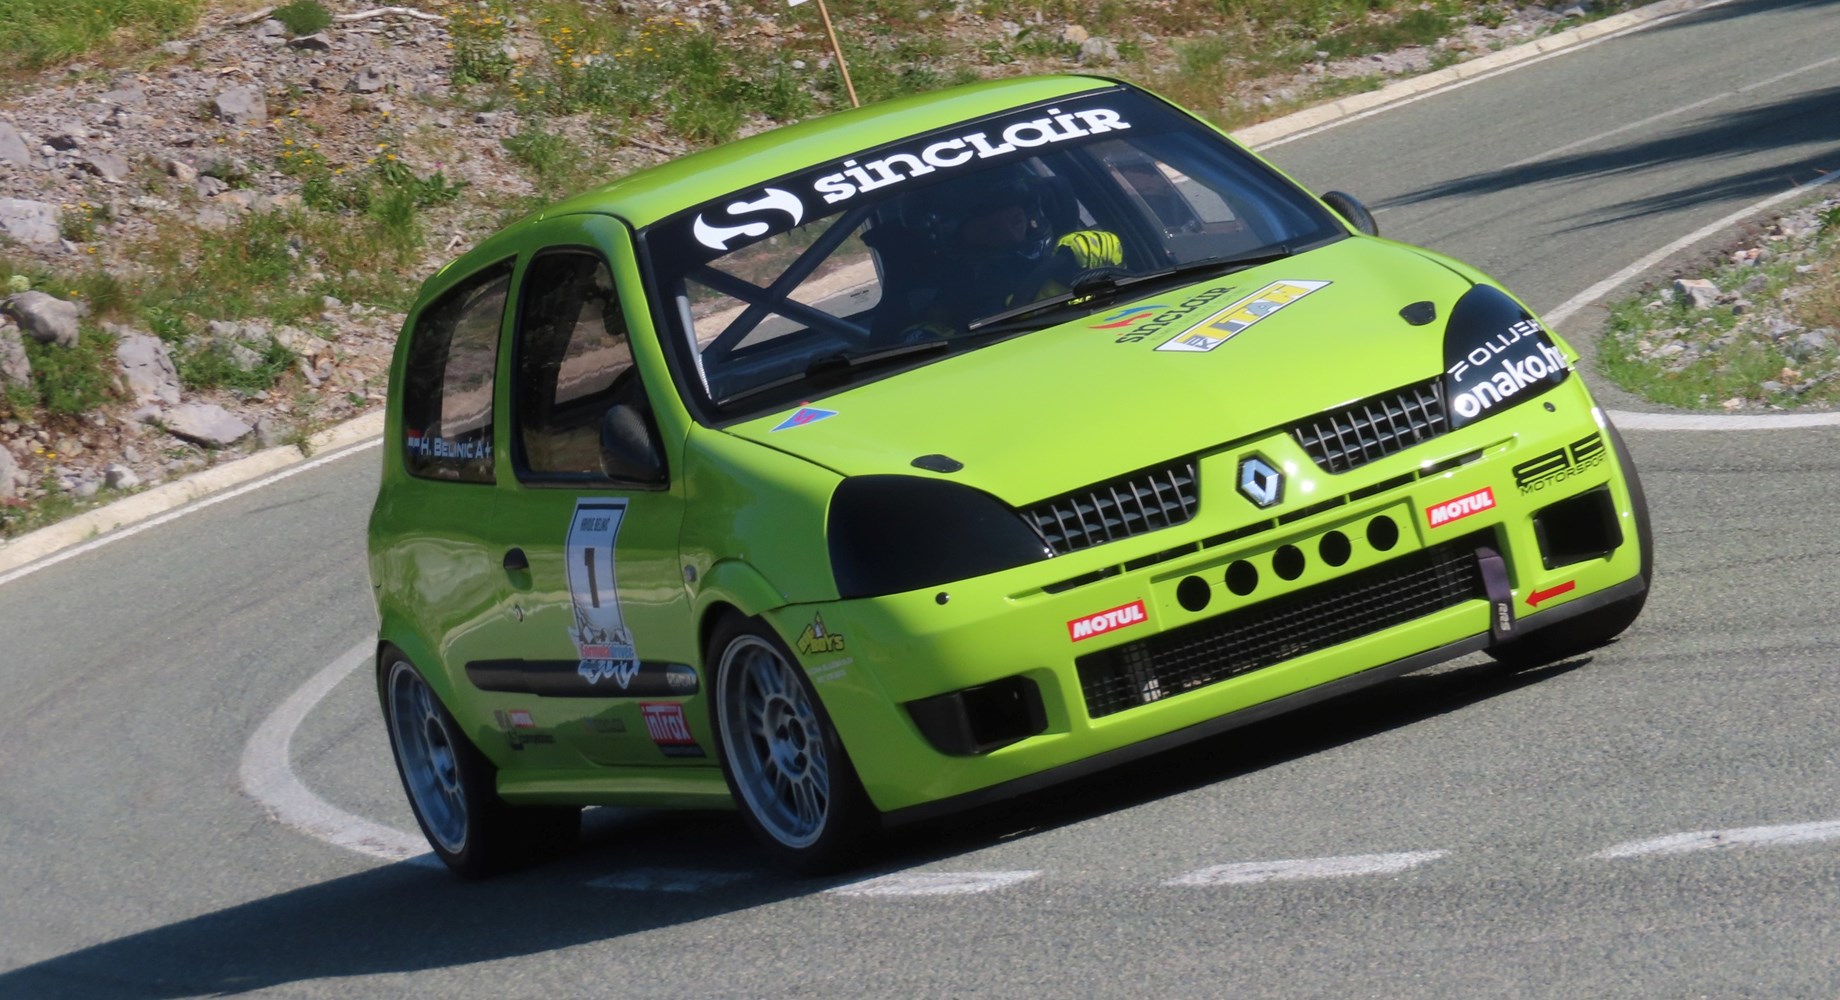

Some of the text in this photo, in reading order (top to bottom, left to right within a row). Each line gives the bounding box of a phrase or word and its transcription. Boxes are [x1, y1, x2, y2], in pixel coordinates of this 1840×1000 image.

[1431, 490, 1494, 525] MOTUL
[584, 547, 600, 608] 1
[1073, 604, 1144, 639] MOTUL
